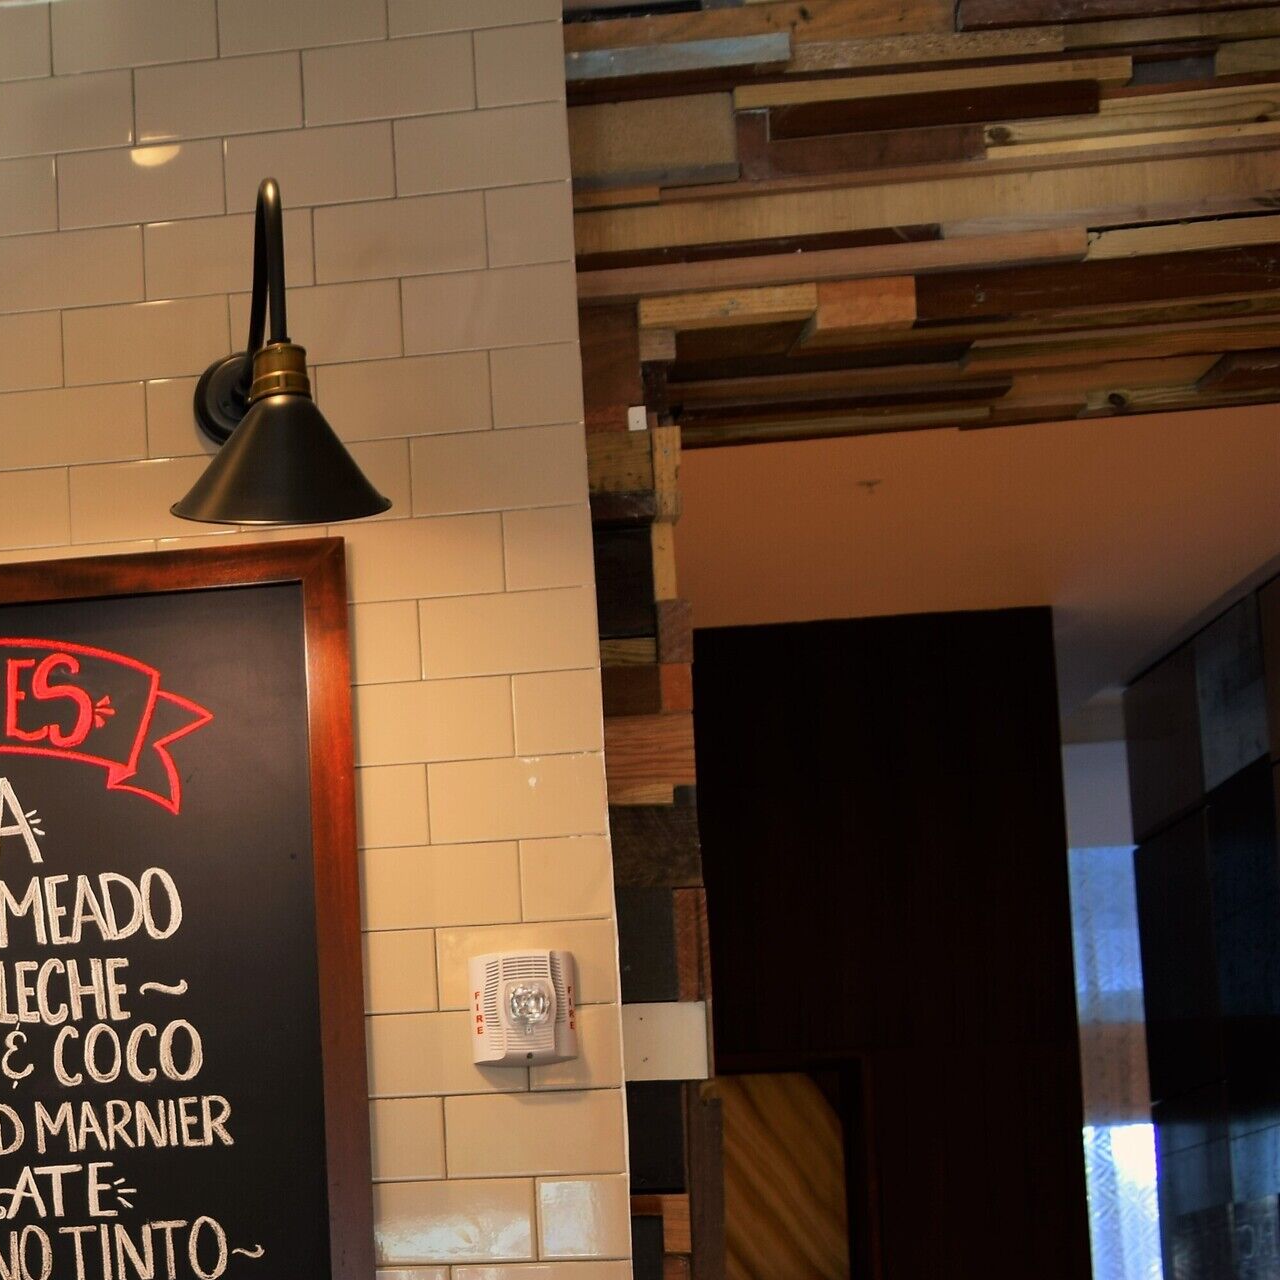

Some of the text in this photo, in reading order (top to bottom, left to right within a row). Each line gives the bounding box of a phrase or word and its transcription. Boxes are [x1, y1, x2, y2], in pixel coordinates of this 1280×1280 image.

[474, 991, 484, 1035] FIRE
[54, 1021, 203, 1086] COCO
[38, 1096, 234, 1153] MARNIER
